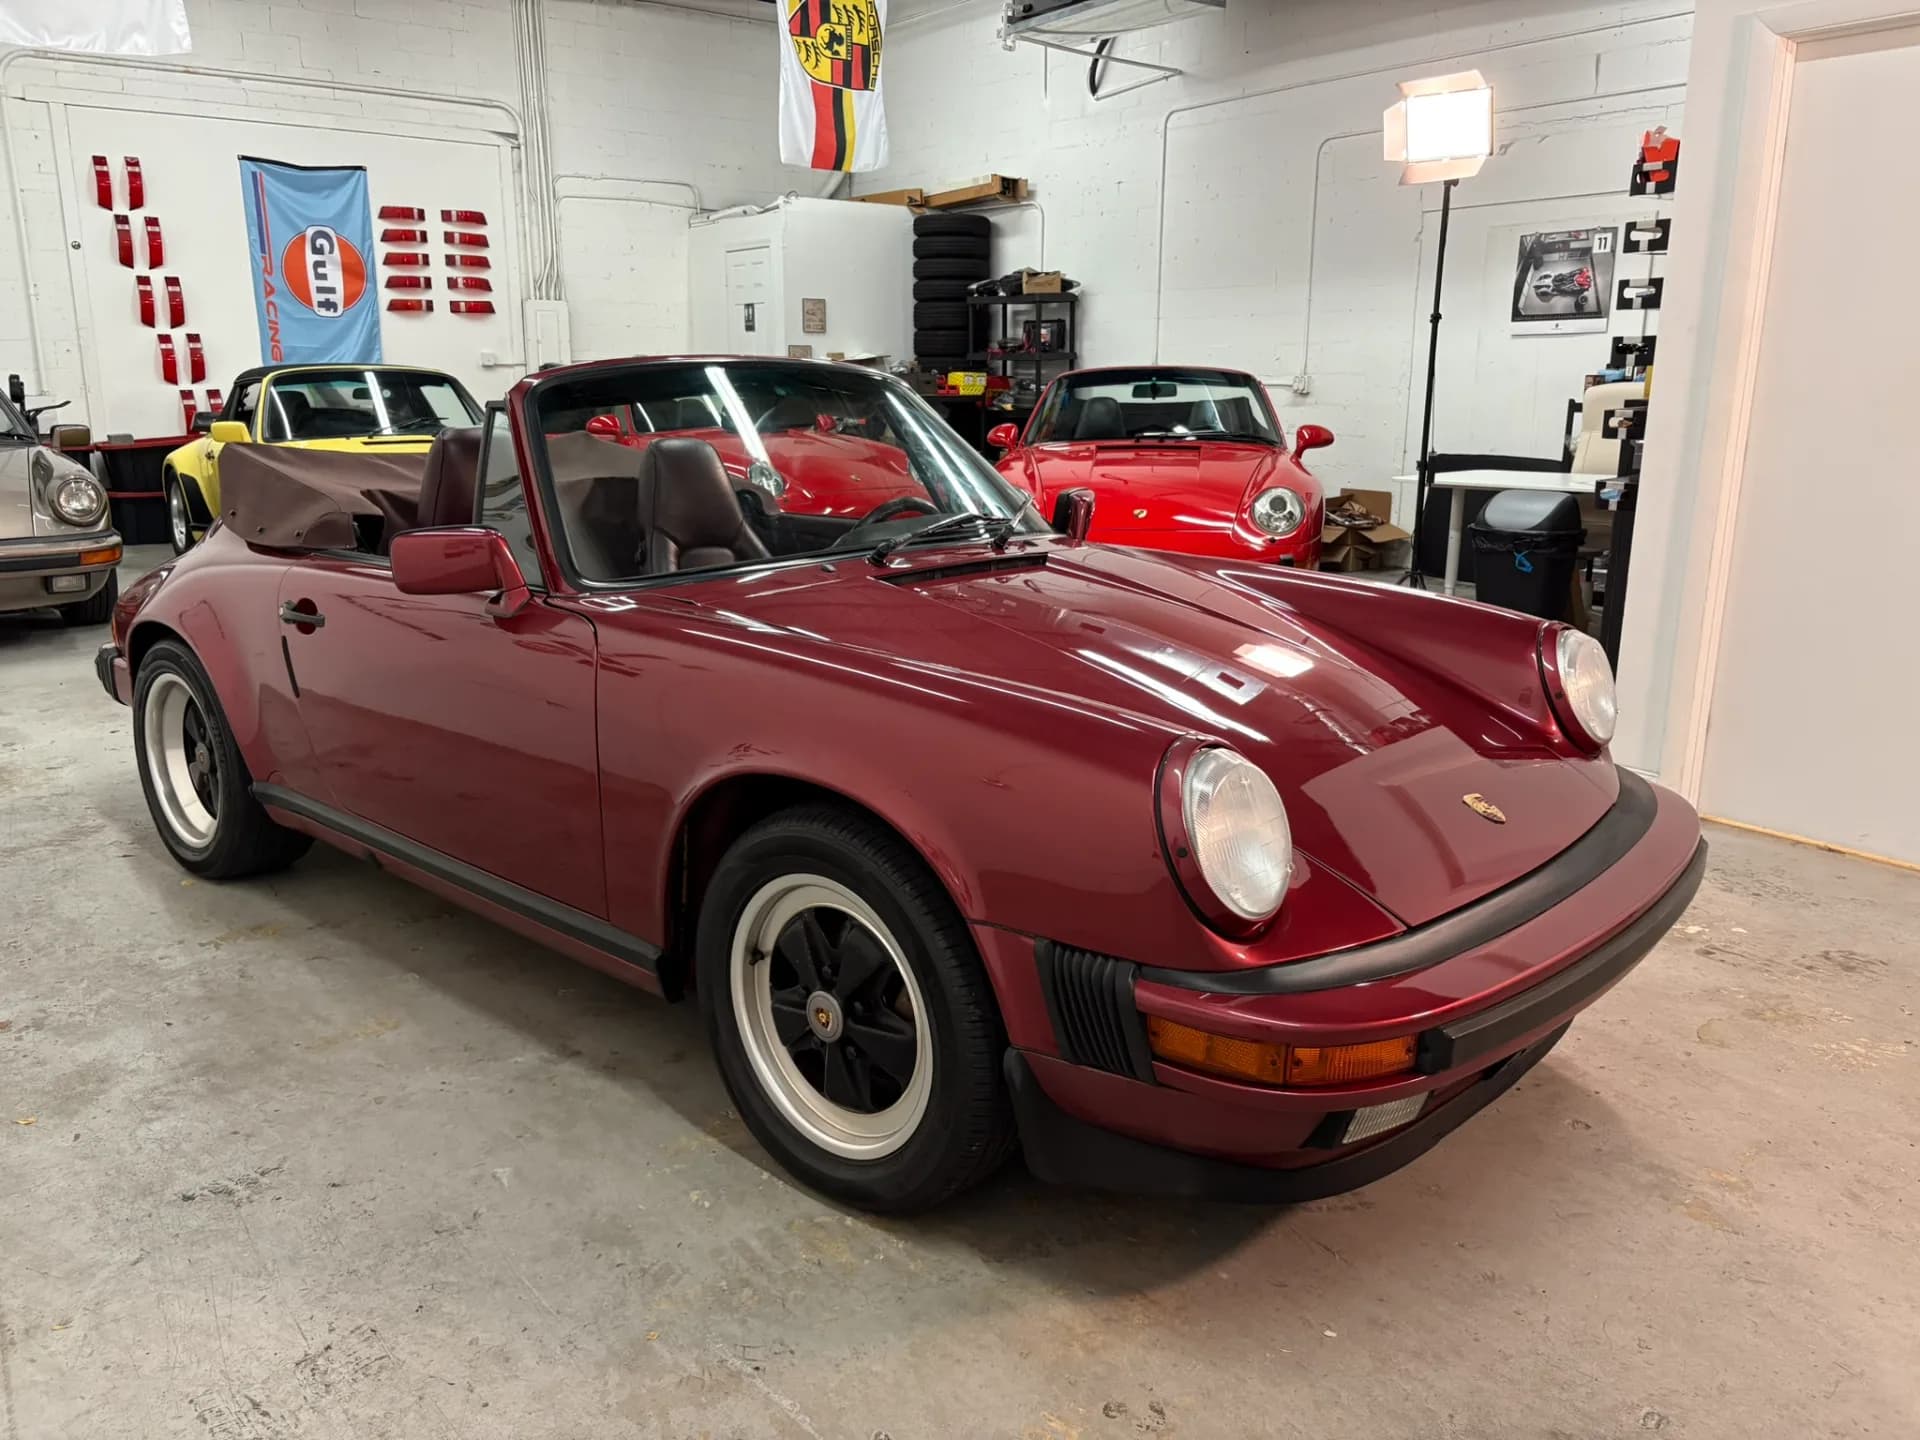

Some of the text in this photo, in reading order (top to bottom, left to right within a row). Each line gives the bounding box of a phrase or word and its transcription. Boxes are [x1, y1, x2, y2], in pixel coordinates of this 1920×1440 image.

[868, 1, 881, 88] PORSCHE
[310, 230, 339, 313] Gulf
[1598, 236, 1608, 250] 11
[261, 256, 284, 363] RACING
